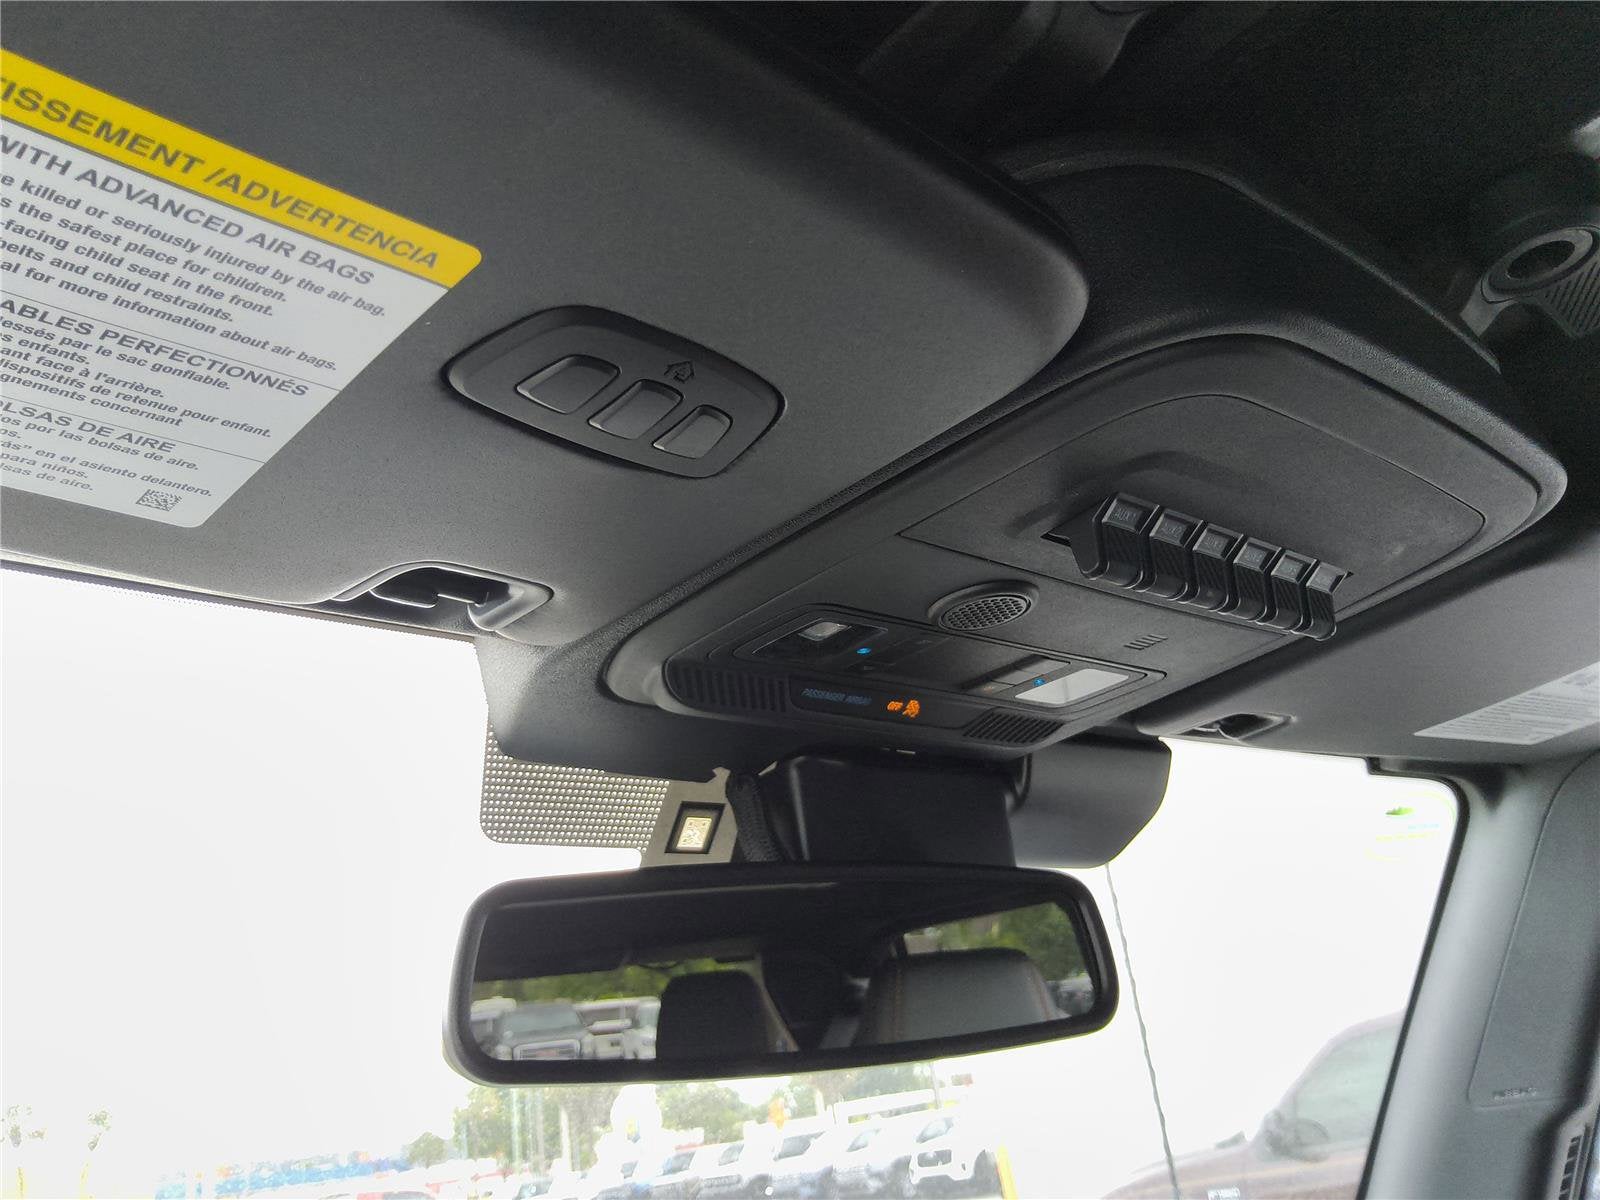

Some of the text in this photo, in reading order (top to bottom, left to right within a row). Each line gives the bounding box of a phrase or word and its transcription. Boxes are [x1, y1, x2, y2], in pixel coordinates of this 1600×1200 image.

[0, 76, 438, 269] ISSEMENT /ADVERTENCIA
[17, 201, 53, 223] the
[57, 217, 123, 247] safest
[122, 241, 178, 266] place
[182, 259, 211, 276] for
[212, 271, 286, 302] children.
[19, 178, 82, 210] killed
[84, 205, 110, 220] or
[111, 215, 202, 254] seriously
[203, 245, 271, 276] injured
[270, 268, 295, 285] by
[296, 277, 325, 295] the
[326, 290, 353, 303] air
[352, 294, 385, 316] bag.
[74, 168, 244, 238] ADVANCED
[245, 232, 297, 258] AIR
[298, 250, 375, 285] BAGS
[48, 257, 90, 276] and
[92, 271, 142, 293] child
[143, 287, 233, 322] restraints.
[73, 245, 125, 268] child
[126, 263, 171, 283] seat
[171, 275, 192, 290] in
[195, 283, 225, 300] the
[228, 294, 273, 316] front.
[0, 299, 309, 396] ABLES PERFECTIONNÉS
[24, 266, 56, 284] for
[57, 279, 109, 302] more
[112, 295, 217, 334] information
[219, 330, 270, 350] about
[270, 345, 296, 357] air
[296, 351, 337, 371] bags.
[17, 338, 90, 365] enfants.
[35, 355, 75, 373] face
[78, 367, 91, 378] à
[94, 371, 164, 398] l'arrière.
[57, 336, 93, 351] par
[94, 345, 113, 357] le
[115, 353, 149, 367] sac
[149, 362, 230, 390] gonflable.
[0, 400, 177, 453] LSAS DE AIRE
[89, 384, 112, 396] de
[114, 391, 179, 413] retenue
[179, 408, 220, 423] pour
[220, 419, 271, 438] enfant.
[89, 398, 183, 427] concernant
[24, 422, 57, 434] por
[58, 429, 85, 442] las
[87, 436, 141, 456] bolsas
[143, 451, 164, 462] de
[165, 458, 199, 471] aire.
